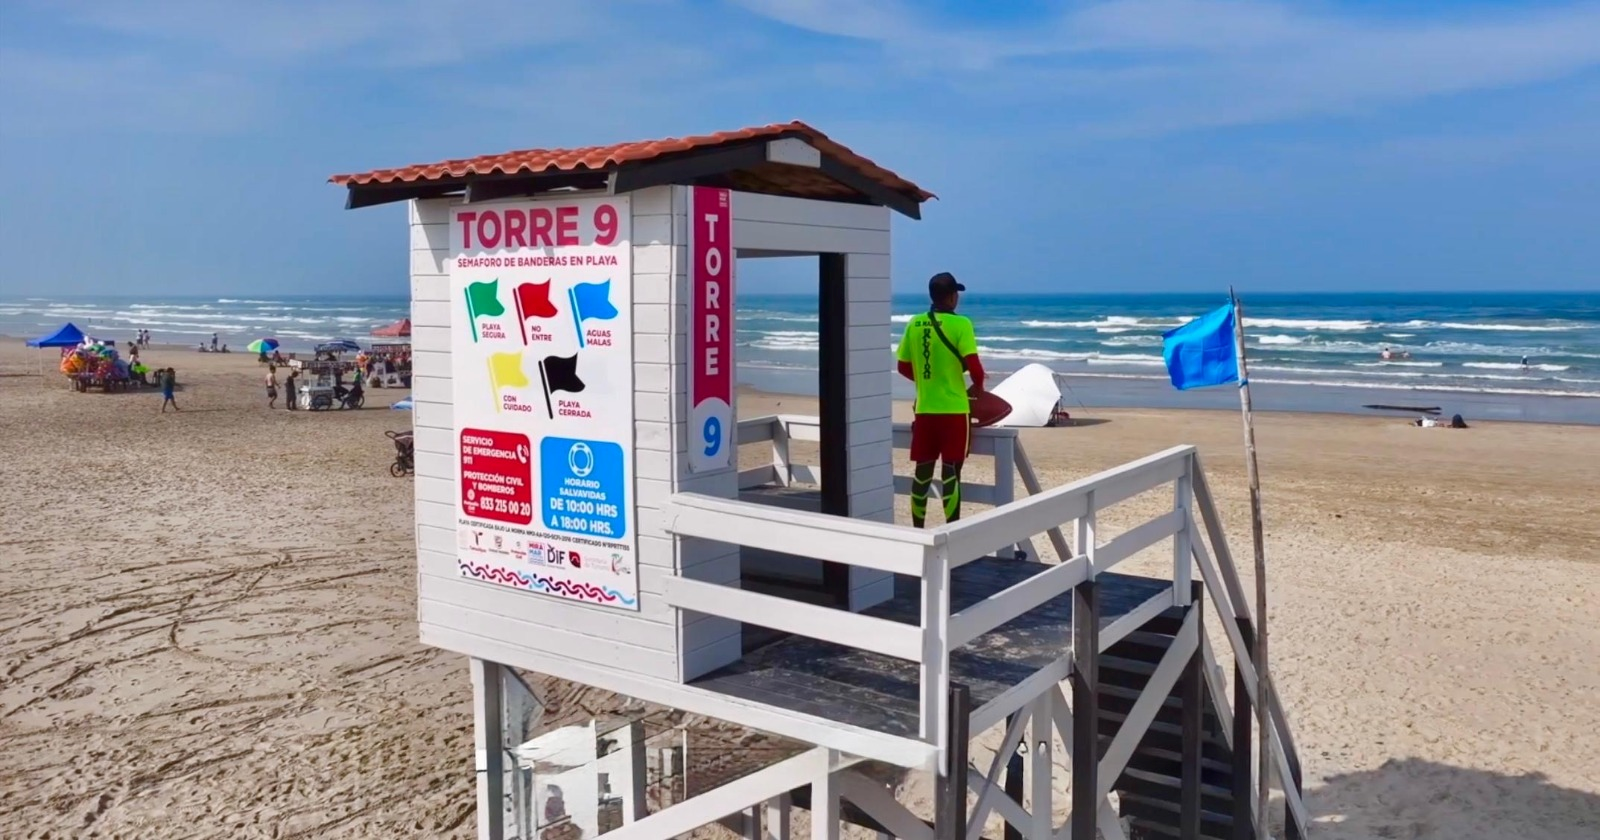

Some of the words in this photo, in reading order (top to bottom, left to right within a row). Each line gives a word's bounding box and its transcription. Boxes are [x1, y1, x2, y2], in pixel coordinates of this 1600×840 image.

[457, 206, 579, 249] TORRE
[594, 204, 618, 246] 9
[458, 257, 501, 268] SEMAFORO
[504, 257, 516, 267] DE
[518, 256, 567, 267] BANDERAS
[570, 256, 583, 266] EN
[586, 255, 618, 266] PLAYA
[705, 213, 721, 375] TORRE
[482, 323, 501, 331] PLAYA
[482, 331, 506, 339] SEGURA
[532, 334, 552, 342] ENTRE
[586, 329, 611, 338] AGUAS
[586, 338, 612, 346] MALAS
[503, 394, 517, 402] CON
[558, 400, 581, 408] PLAYA
[503, 403, 532, 412] CUIDADO
[558, 408, 592, 418] CERRADA
[462, 435, 493, 446] SERVICIO
[704, 416, 721, 456] 9
[462, 445, 472, 454] DE
[473, 446, 517, 460] EMERGENCIA
[463, 456, 473, 465] 911
[463, 470, 505, 484] PROTECCIÓN
[505, 476, 524, 487] CIVIL
[564, 477, 600, 489] HORARIO
[472, 481, 478, 490] Y
[478, 482, 515, 495] BOMBEROS
[559, 487, 606, 501] SALVAVIDAS
[480, 496, 494, 511] 833
[495, 498, 507, 513] 215
[508, 500, 519, 515] 00
[520, 502, 531, 517] 20
[550, 497, 564, 511] DE
[565, 499, 594, 515] 10:00
[596, 503, 618, 518] HRS
[550, 514, 559, 527] A
[560, 515, 587, 531] 18:00
[589, 519, 614, 535] HRS.
